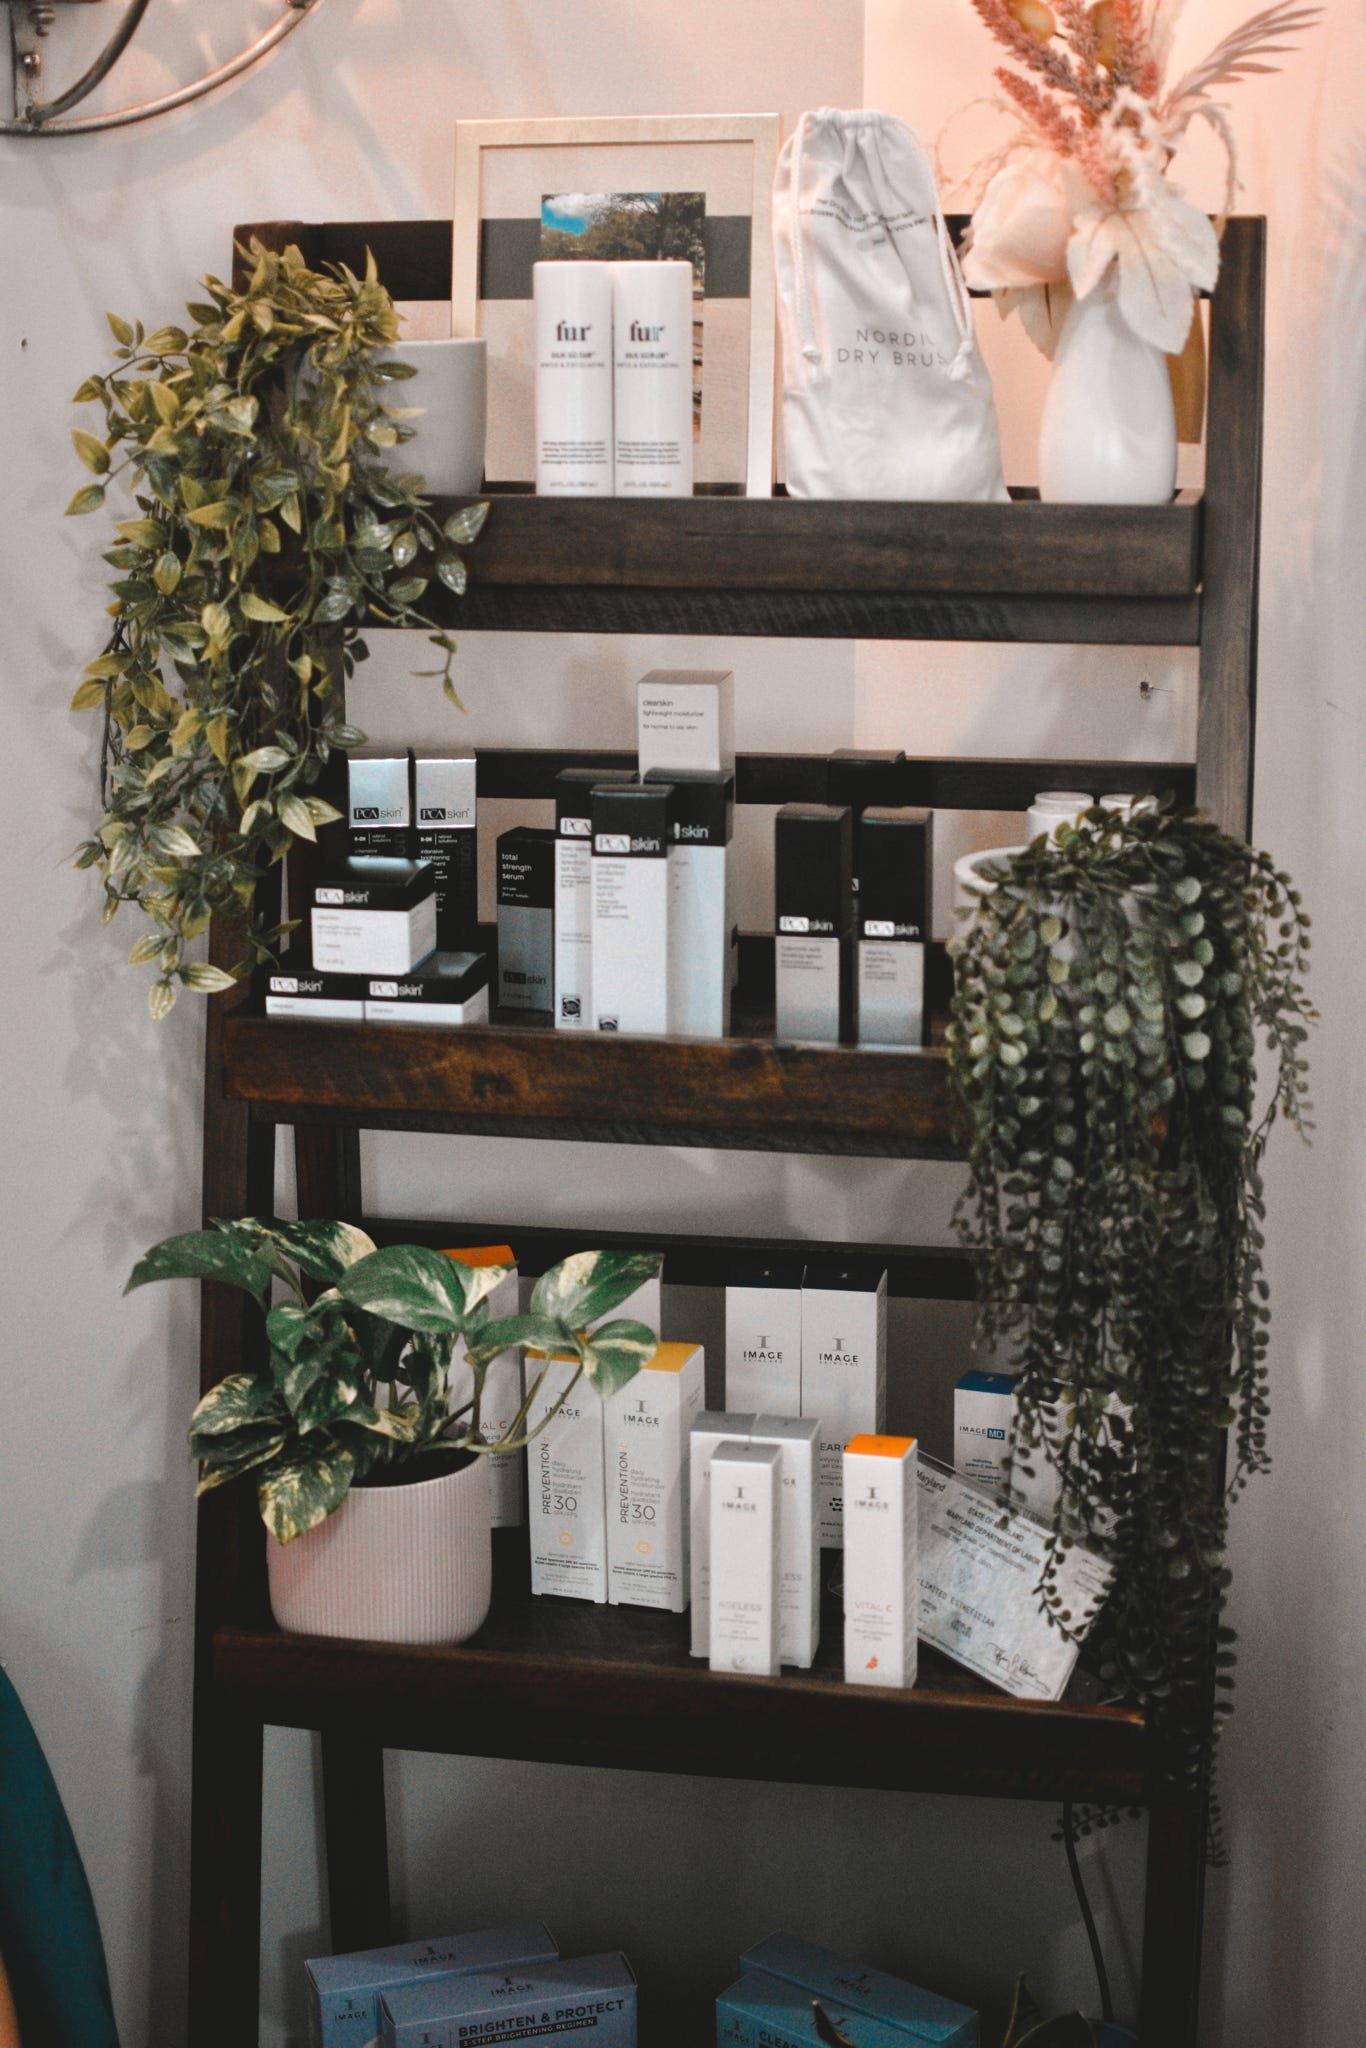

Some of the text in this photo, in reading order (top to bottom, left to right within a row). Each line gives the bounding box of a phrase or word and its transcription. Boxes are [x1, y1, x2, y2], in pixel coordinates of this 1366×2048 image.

[557, 320, 591, 342] fur
[630, 320, 665, 342] fur
[857, 329, 934, 347] NORDI
[838, 348, 949, 368] DRY BRU
[354, 807, 402, 820] PCA skin
[420, 808, 469, 820] PCA skin
[561, 818, 592, 836] PCA
[681, 824, 709, 839] skin
[595, 834, 631, 853] PCA
[631, 837, 660, 851] skin
[501, 853, 519, 861] total
[502, 863, 533, 873] strength
[502, 873, 525, 881] serum
[315, 888, 369, 905] PCA skin
[809, 919, 834, 932] skin
[895, 923, 920, 936] skin
[270, 977, 322, 993] PCA skin
[369, 981, 422, 997] PCA skin
[743, 1351, 783, 1360] IMAGE
[818, 1353, 859, 1363] IMAGE
[623, 1415, 660, 1425] IMAGE
[959, 1425, 1006, 1441] IMAGE MD
[820, 1442, 842, 1452] EAR
[916, 1469, 946, 1492] Maryland
[554, 1495, 578, 1512] 30
[722, 1502, 757, 1512] IMAGE
[854, 1500, 889, 1511] IMAGE
[632, 1503, 656, 1521] 30
[974, 1525, 1013, 1551] DEPARTMENT
[992, 1521, 1025, 1543] MYLAND
[919, 1579, 948, 1600] LIMITED
[413, 1953, 456, 1967] IMAGE
[490, 1983, 533, 1998] IMAGE
[334, 2010, 368, 2023] IMAGE
[458, 1999, 625, 2038] BRIGHTEN & PROTECT
[494, 2025, 554, 2041] BRIGHTENING
[555, 2018, 595, 2033] REGIMEN
